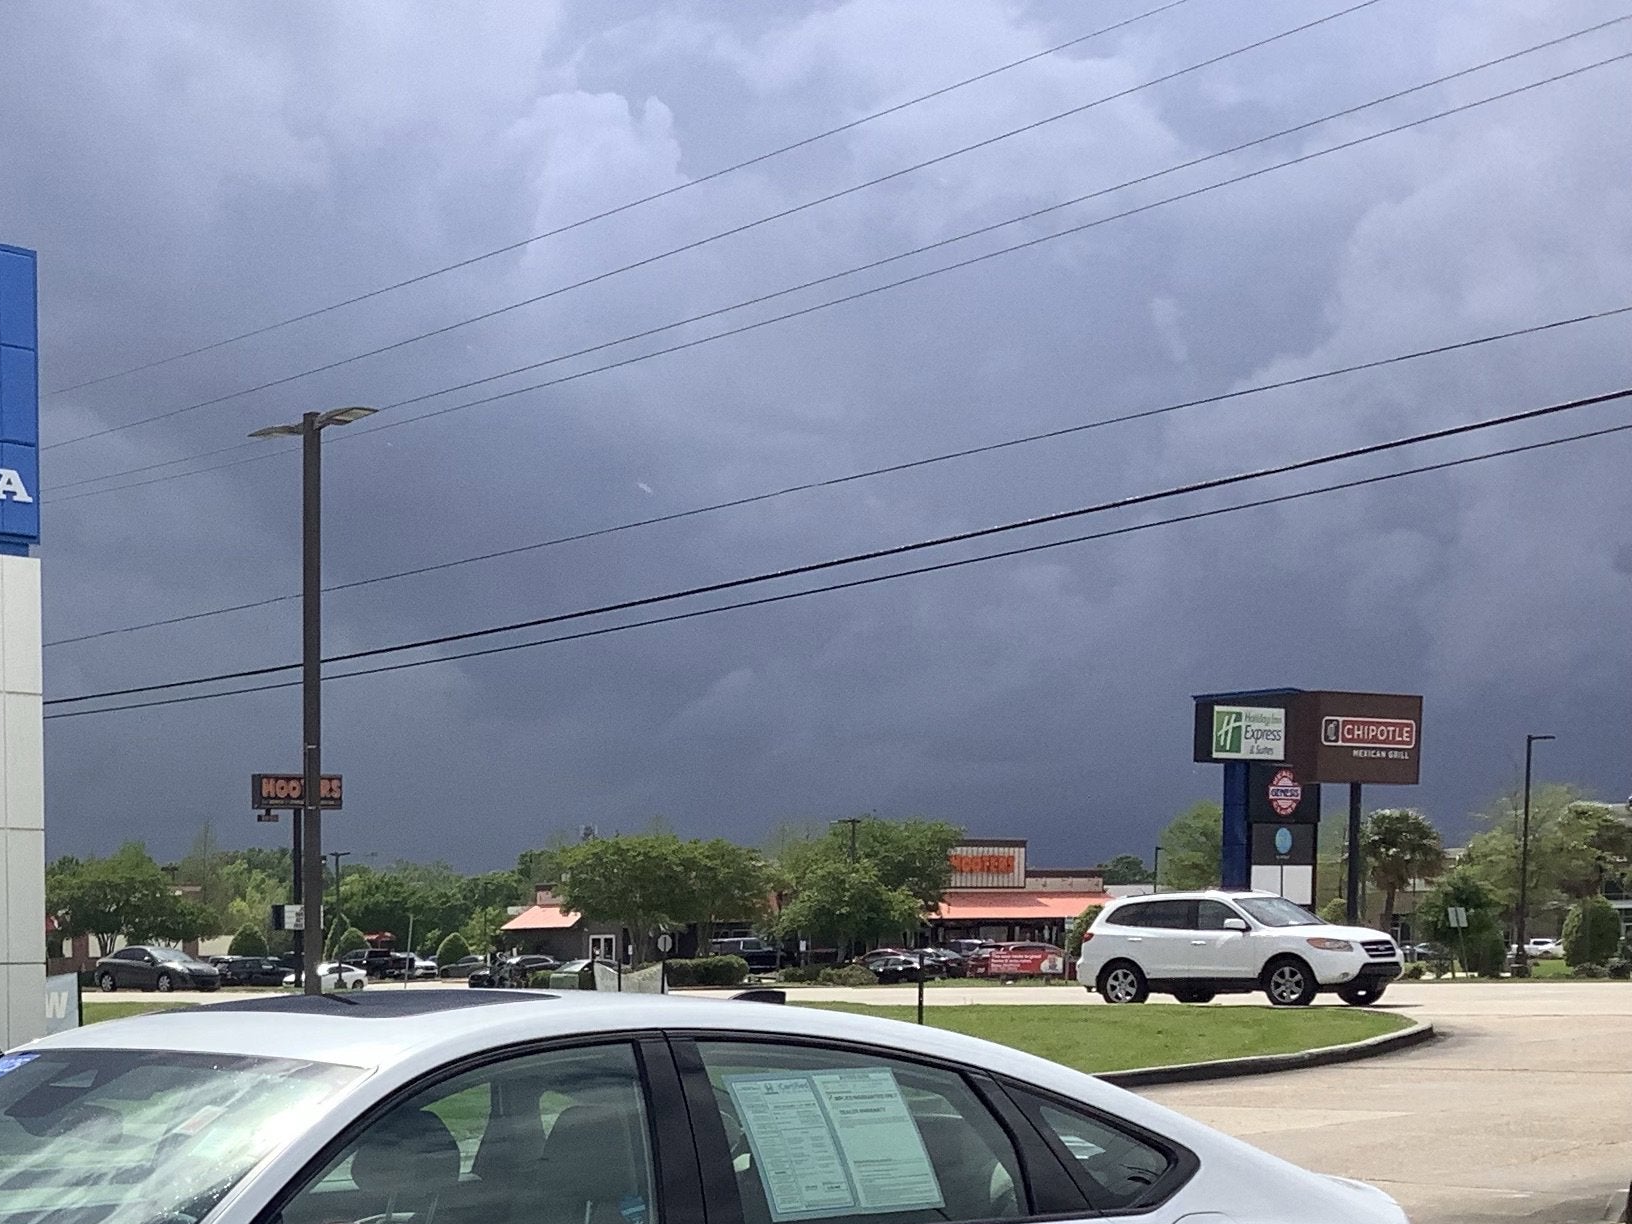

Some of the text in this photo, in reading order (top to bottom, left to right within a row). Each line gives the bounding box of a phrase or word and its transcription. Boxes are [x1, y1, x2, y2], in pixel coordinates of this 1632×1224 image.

[1244, 725, 1282, 744] Express
[1344, 724, 1411, 742] CHIPOTLE
[1352, 749, 1409, 760] MEXICAN GRILL
[261, 777, 341, 798] HOORS
[1270, 788, 1299, 798] GENESIS
